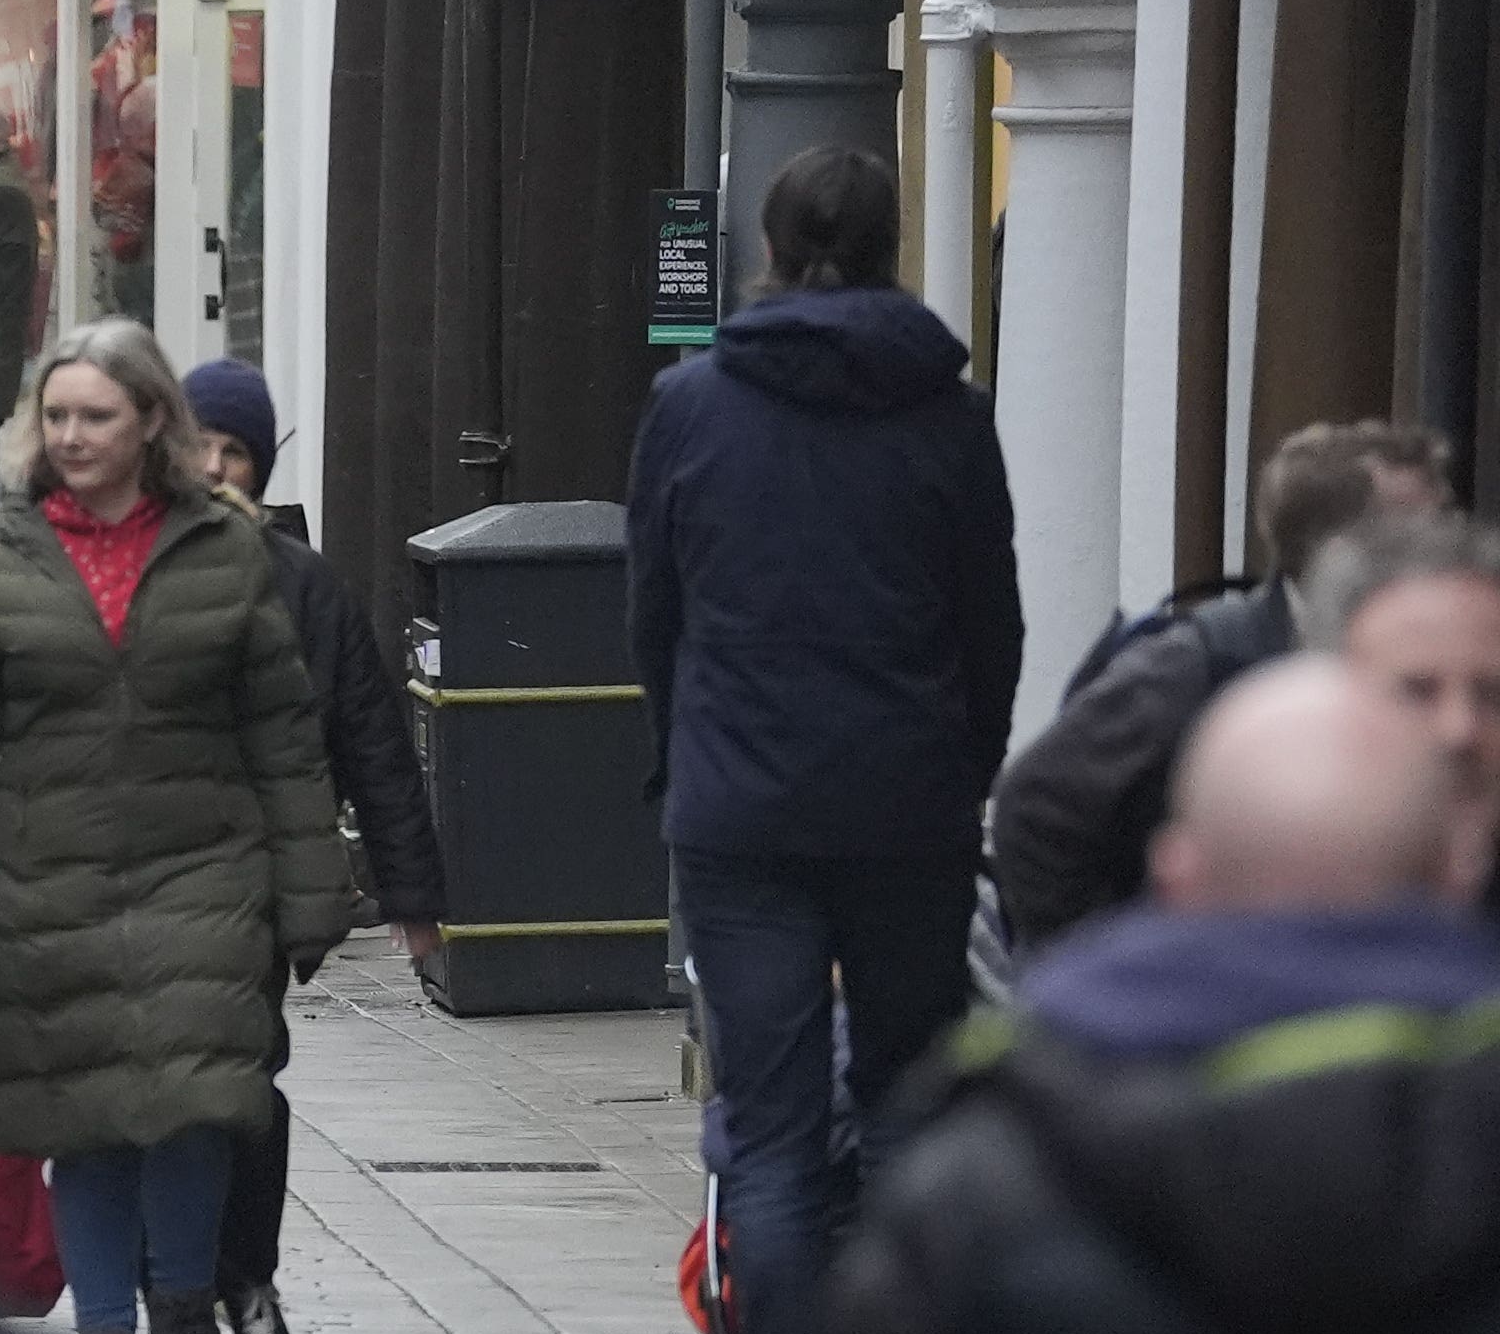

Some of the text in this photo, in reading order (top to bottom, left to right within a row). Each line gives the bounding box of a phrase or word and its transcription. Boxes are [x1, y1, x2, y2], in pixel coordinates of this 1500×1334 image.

[673, 239, 707, 249] UNUSUAL
[659, 249, 686, 260] LOCAL
[659, 272, 708, 282] WORKSHOPS
[659, 283, 708, 294] AND TOURS
